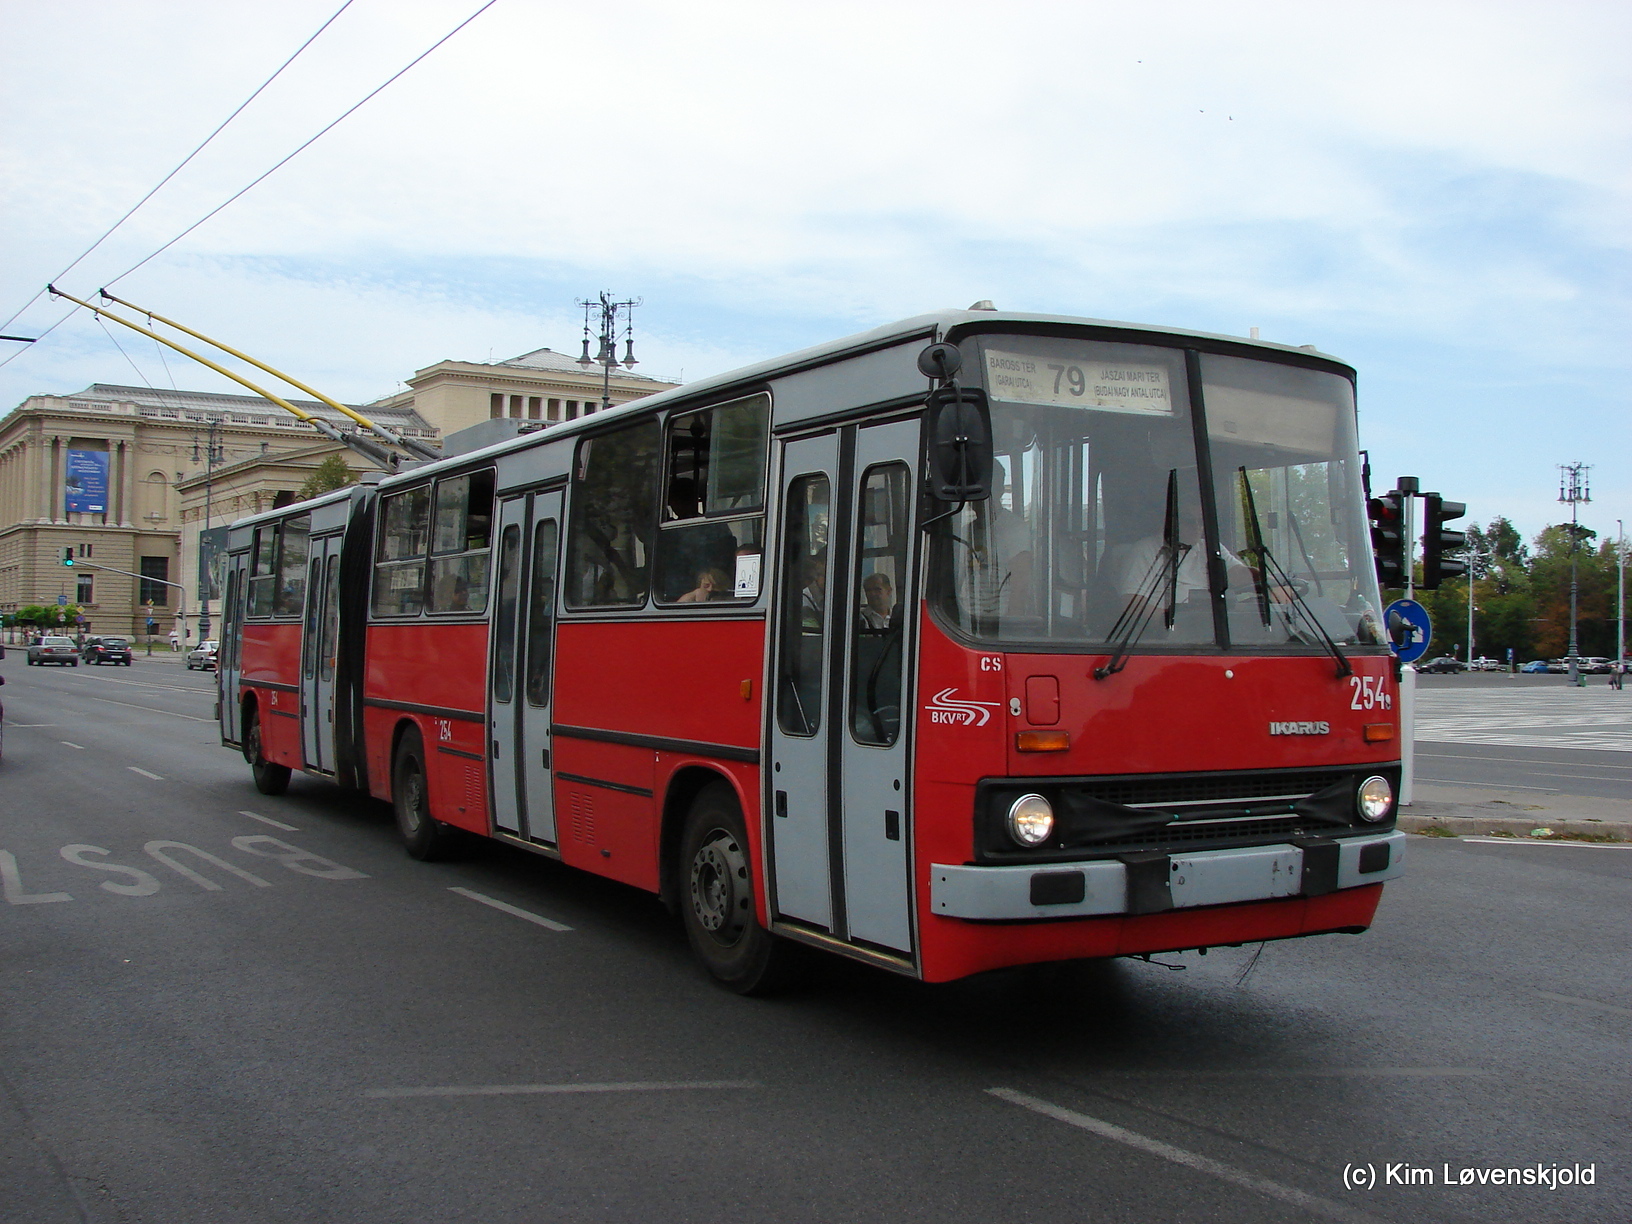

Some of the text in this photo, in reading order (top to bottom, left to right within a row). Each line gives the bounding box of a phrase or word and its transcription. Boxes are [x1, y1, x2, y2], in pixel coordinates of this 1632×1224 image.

[990, 357, 1020, 372] BAROSS
[1047, 363, 1085, 397] 79
[1126, 371, 1145, 383] MARI
[1114, 385, 1130, 398] NAGY
[1131, 387, 1150, 399] ANTAL
[980, 656, 1002, 672] CS
[439, 719, 452, 741] 254
[1269, 721, 1331, 736] IKARUS
